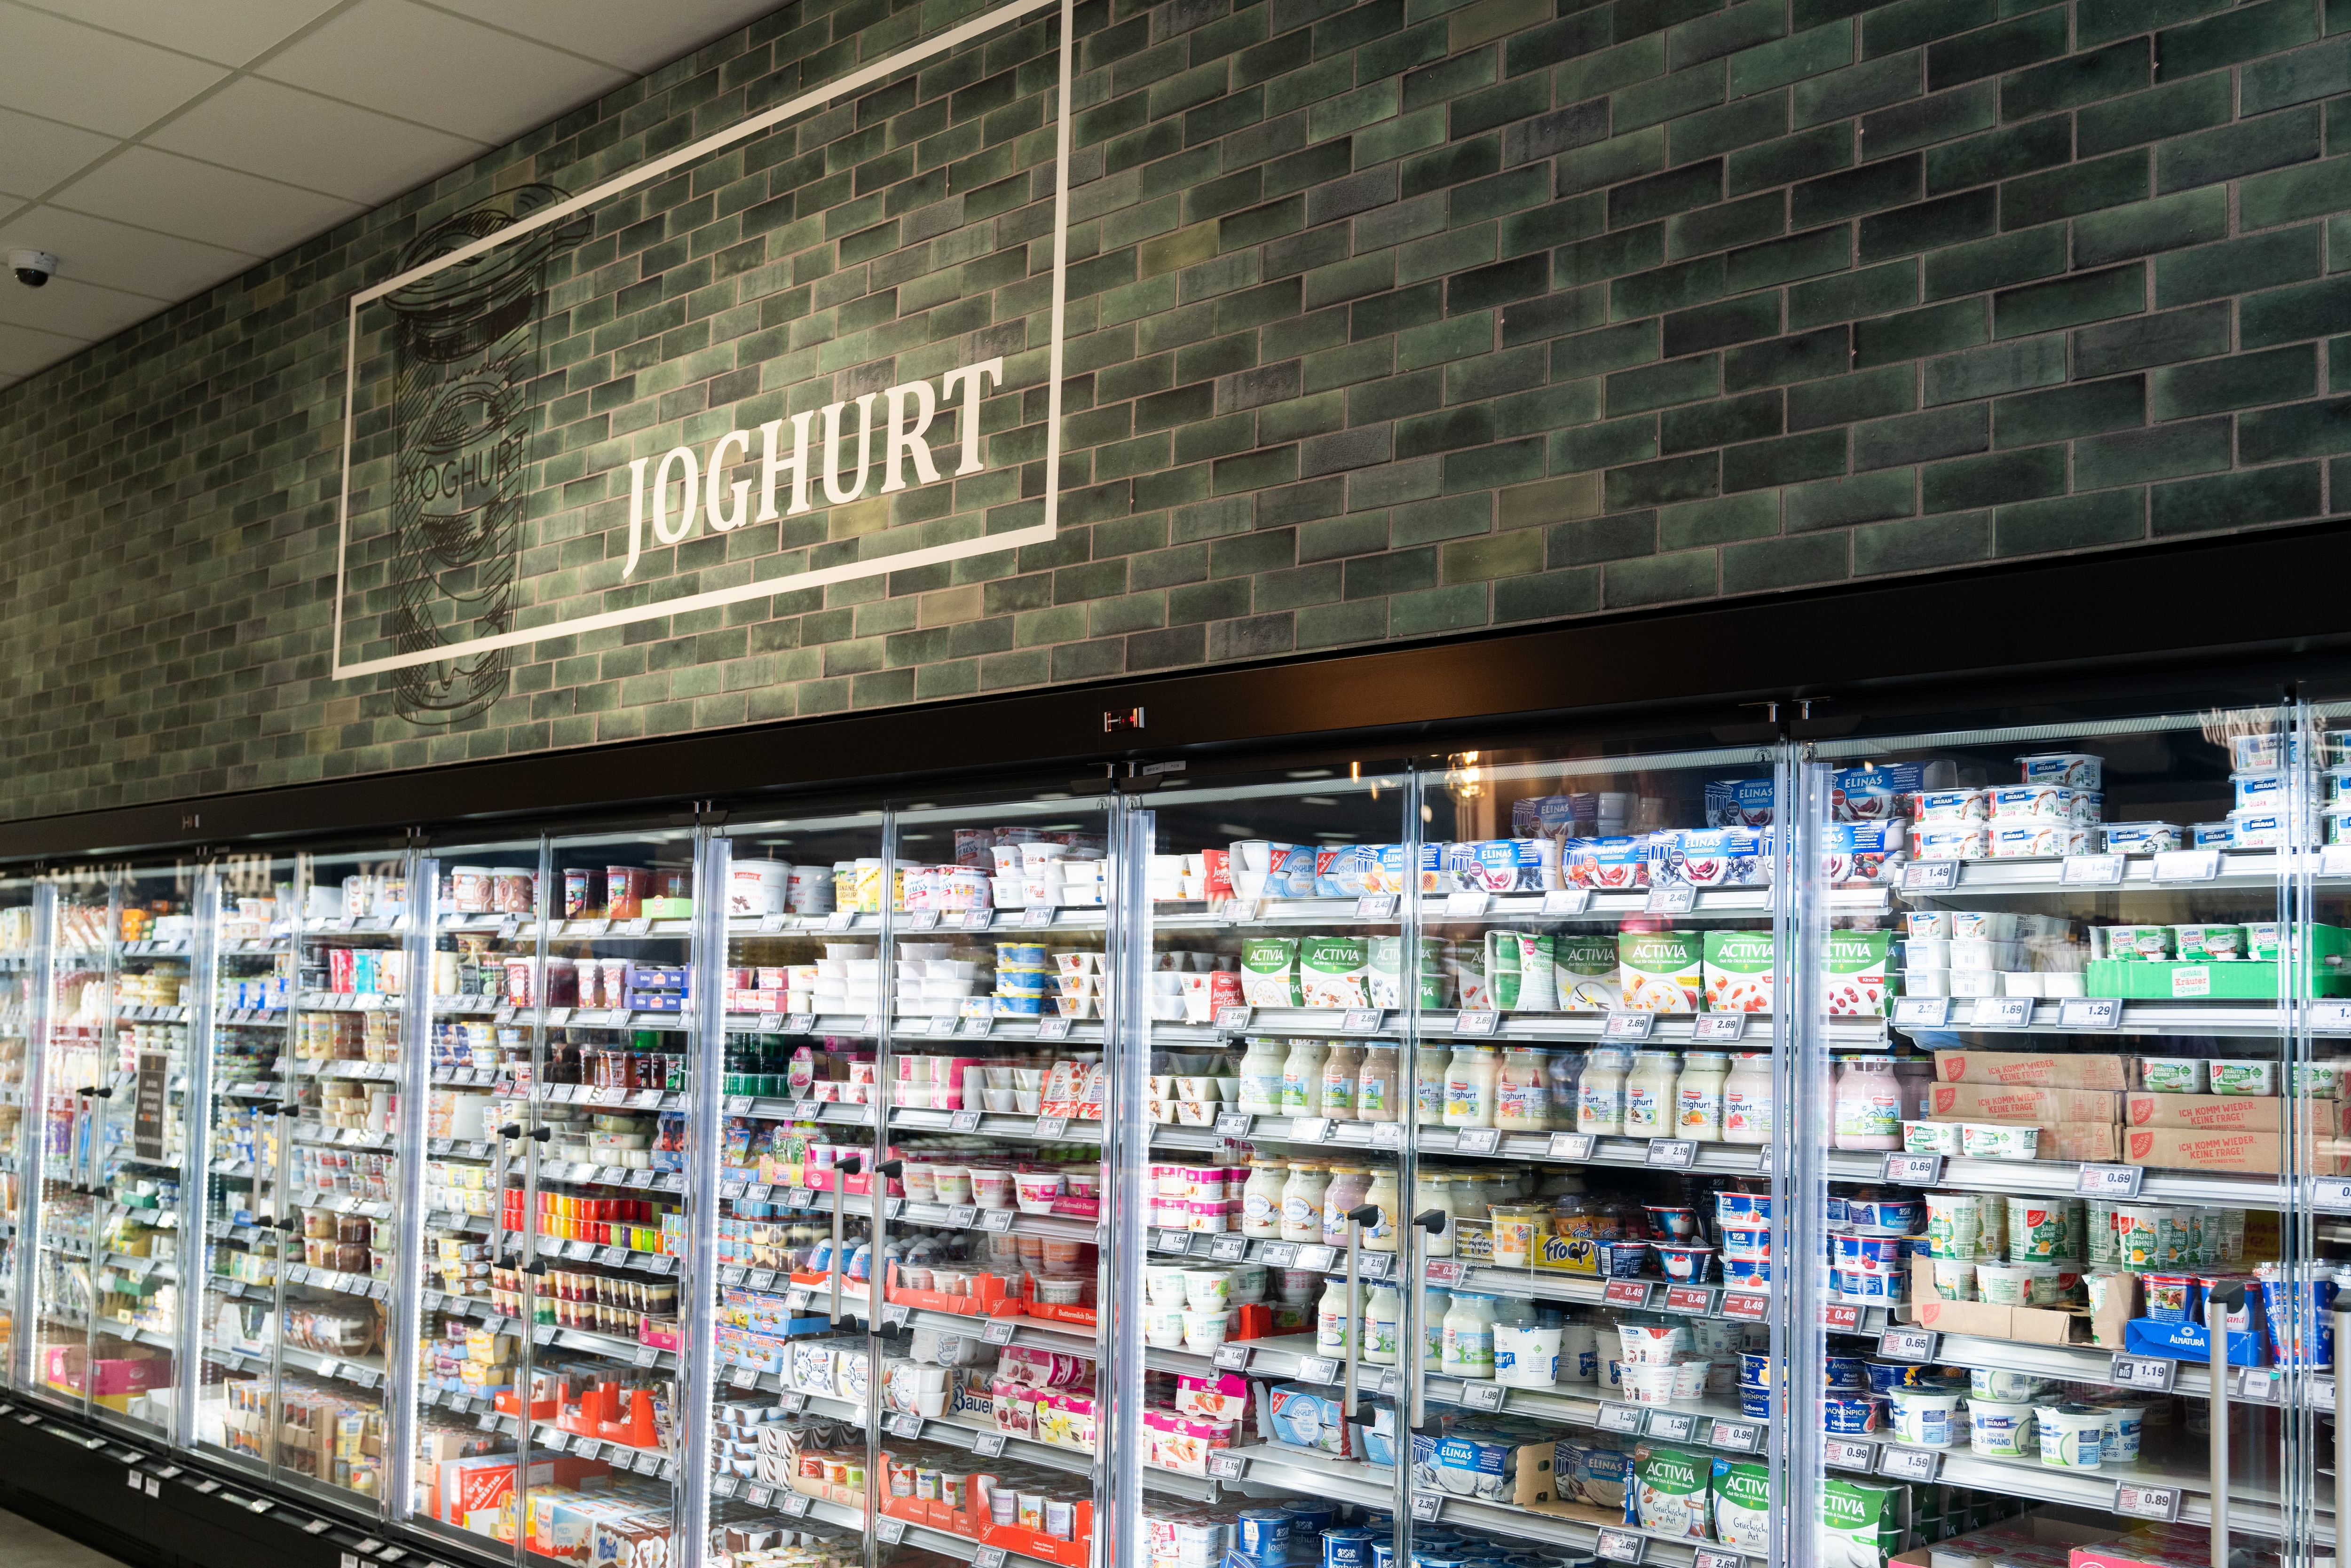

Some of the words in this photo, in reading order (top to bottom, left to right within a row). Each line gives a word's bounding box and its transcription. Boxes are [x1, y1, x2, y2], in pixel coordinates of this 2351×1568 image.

[407, 428, 529, 502] YOGHURT
[623, 355, 1002, 579] JOGHURT
[1845, 775, 1882, 788] ELINAS
[1739, 787, 1773, 798] ELINAS
[1541, 802, 1569, 814] ELINAS
[1685, 838, 1721, 849] ELINAS
[1482, 849, 1512, 859] ELINAS
[1929, 868, 1949, 877] 1.49
[1670, 894, 1687, 902] 2.45
[1250, 949, 1283, 961] ACTIVIA
[1312, 948, 1359, 961] ACTIVIA
[1568, 948, 1615, 961] ACTIVIA
[1633, 945, 1687, 958] ACTIVIA
[2175, 977, 2207, 985] Kräuter
[1212, 989, 1240, 1000] Joghurt
[2002, 1005, 2021, 1014] 1.69
[2089, 1006, 2110, 1015] 1.29
[1475, 1016, 1491, 1024] 2.69
[2003, 1064, 2026, 1073] KOMM
[2028, 1059, 2057, 1071] WIEDER.
[1999, 1072, 2020, 1081] KEINE
[2023, 1069, 2047, 1079] FRAGE!
[1677, 1099, 1711, 1110] Almighurt
[1978, 1098, 1991, 1107] ICH
[1992, 1095, 2014, 1104] KOMM
[2017, 1092, 2047, 1102] WIEDER.
[1988, 1104, 2009, 1113] KEINE
[2012, 1103, 2036, 1112] FRAGE!
[2195, 1106, 2221, 1115] KOMM
[2223, 1102, 2256, 1112] WIEDER.
[2217, 1113, 2244, 1123] FRAGE!
[1479, 1133, 1492, 1143] 2.19
[2195, 1141, 2220, 1149] KOMM
[2223, 1136, 2257, 1146] WIEDER.
[1673, 1147, 1688, 1156] 2.19
[2190, 1150, 2214, 1159] KEINE
[2216, 1147, 2244, 1157] FRAGE!
[1910, 1162, 1931, 1171] 0.69
[2107, 1174, 2130, 1183] 0.69
[1063, 1200, 1095, 1210] Buttermilch-Dessert
[1173, 1235, 1186, 1244] 1.59
[1230, 1243, 1240, 1251] 2.19
[1280, 1248, 1291, 1257] 2.19
[1371, 1259, 1383, 1268] 2.19
[1625, 1287, 1643, 1297] 0.49
[730, 1294, 746, 1304] PAULA
[1688, 1294, 1706, 1304] 0.49
[763, 1301, 781, 1312] PAULA
[1744, 1300, 1763, 1310] 0.49
[1058, 1309, 1084, 1319] Buttermilch
[1835, 1311, 1855, 1320] 0.49
[726, 1332, 742, 1341] PAULA
[2170, 1334, 2205, 1347] ALNATURA
[757, 1339, 774, 1348] PAULA
[1906, 1338, 1926, 1347] 0.65
[1232, 1351, 1242, 1360] 1.49
[805, 1360, 829, 1374] Bauer
[1319, 1364, 1331, 1373] 1.69
[2142, 1365, 2164, 1377] 1.19
[2119, 1369, 2130, 1378] BIO
[969, 1388, 992, 1399] Privatmolkerei
[1482, 1390, 1497, 1399] 1.99
[952, 1384, 993, 1414] Bauer
[1619, 1412, 1636, 1422] 1.39
[907, 1421, 918, 1430] 1.69
[1670, 1420, 1688, 1430] 1.39
[1733, 1430, 1752, 1440] 0.99
[988, 1439, 999, 1448] 1.49
[1980, 1436, 2010, 1446] SCHMAND
[1441, 1446, 1472, 1460] ELINAS
[1846, 1448, 1868, 1458] 0.99
[1225, 1460, 1238, 1470] 1.19
[1589, 1458, 1622, 1472] ELINAS
[1908, 1457, 1928, 1467] 1.59
[1646, 1461, 1695, 1483] ACTIVIA
[468, 1475, 483, 1494] GUT
[470, 1475, 501, 1510] GÜNSTIG
[759, 1490, 768, 1498] 1.19
[1418, 1499, 1434, 1509] 2.35
[2145, 1495, 2169, 1505] 0.89
[909, 1506, 923, 1515] Fettarmer
[1653, 1502, 1687, 1518] Griechischer
[930, 1511, 950, 1521] Fruchtjoghurt
[1666, 1515, 1676, 1525] Art
[1748, 1531, 1759, 1541] Art
[598, 1536, 617, 1560] Monte
[1619, 1539, 1636, 1549] 2.69
[1717, 1559, 1735, 1568] 2.69
